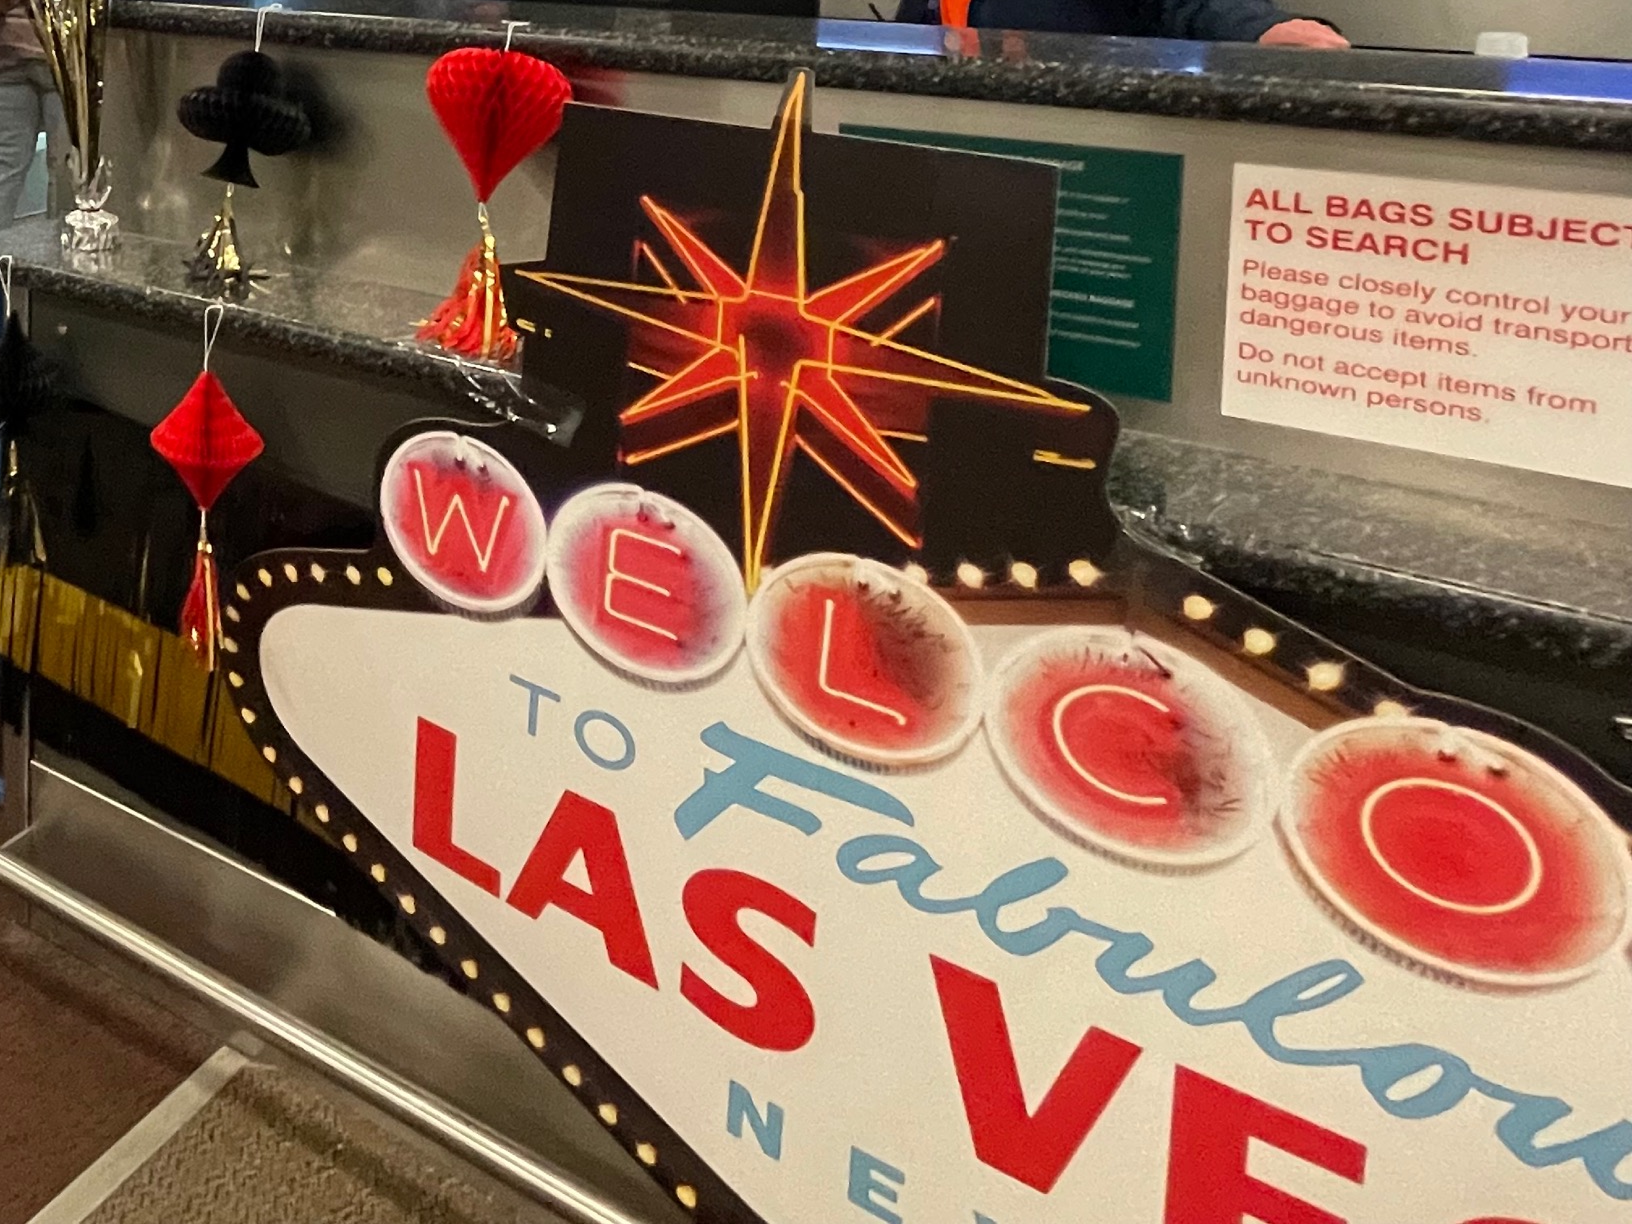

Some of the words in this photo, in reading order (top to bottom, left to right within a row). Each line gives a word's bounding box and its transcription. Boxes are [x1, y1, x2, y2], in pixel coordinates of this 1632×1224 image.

[1245, 188, 1313, 214] ALL
[1325, 195, 1434, 227] BAGS
[1244, 219, 1293, 244] TO
[1305, 226, 1470, 265] SEARCH
[1241, 283, 1360, 316] baggage
[1369, 301, 1395, 320] to
[1405, 309, 1483, 332] avoid
[1243, 259, 1329, 286] Please
[1339, 272, 1436, 304] closely
[1446, 288, 1550, 315] control
[1560, 302, 1629, 325] your
[1240, 308, 1383, 343] dangerous
[1393, 331, 1478, 358] items.
[1237, 368, 1356, 402] unknown
[1367, 388, 1490, 424] persons.
[1238, 341, 1274, 364] Do
[1283, 351, 1324, 372] not
[1335, 358, 1428, 389] accept
[1437, 374, 1516, 403] items
[1527, 385, 1597, 414] from
[510, 673, 636, 771] TO
[412, 715, 816, 1052] LAS
